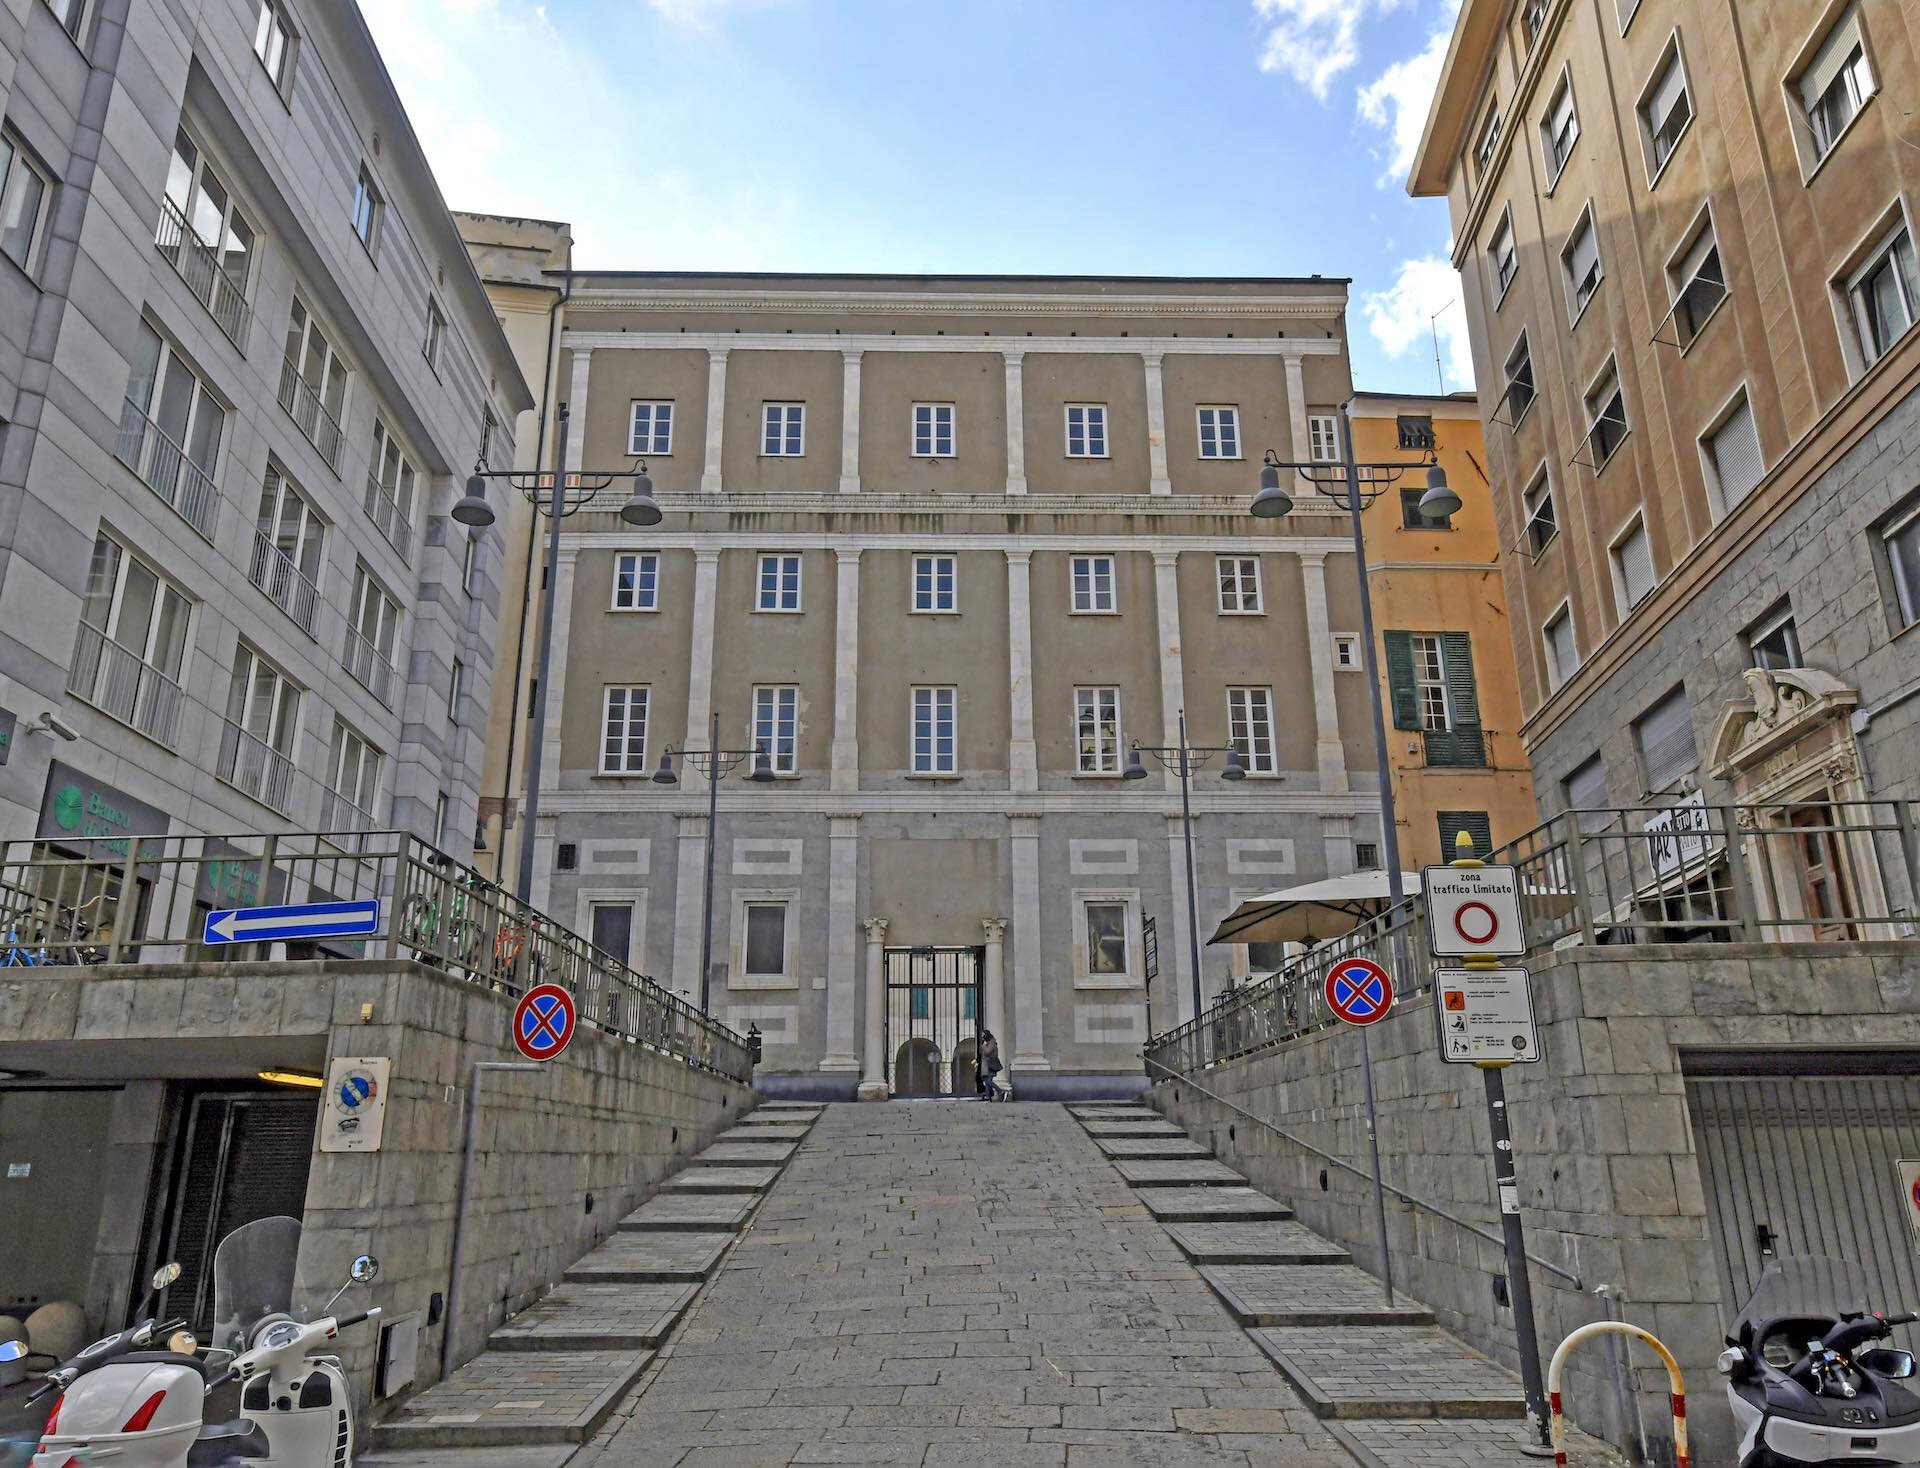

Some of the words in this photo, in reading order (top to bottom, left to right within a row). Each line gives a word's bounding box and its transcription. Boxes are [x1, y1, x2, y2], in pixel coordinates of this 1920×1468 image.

[87, 793, 130, 829] Banco
[1460, 874, 1481, 882] zona
[1433, 884, 1470, 894] traffico
[1473, 884, 1512, 894] limitato
